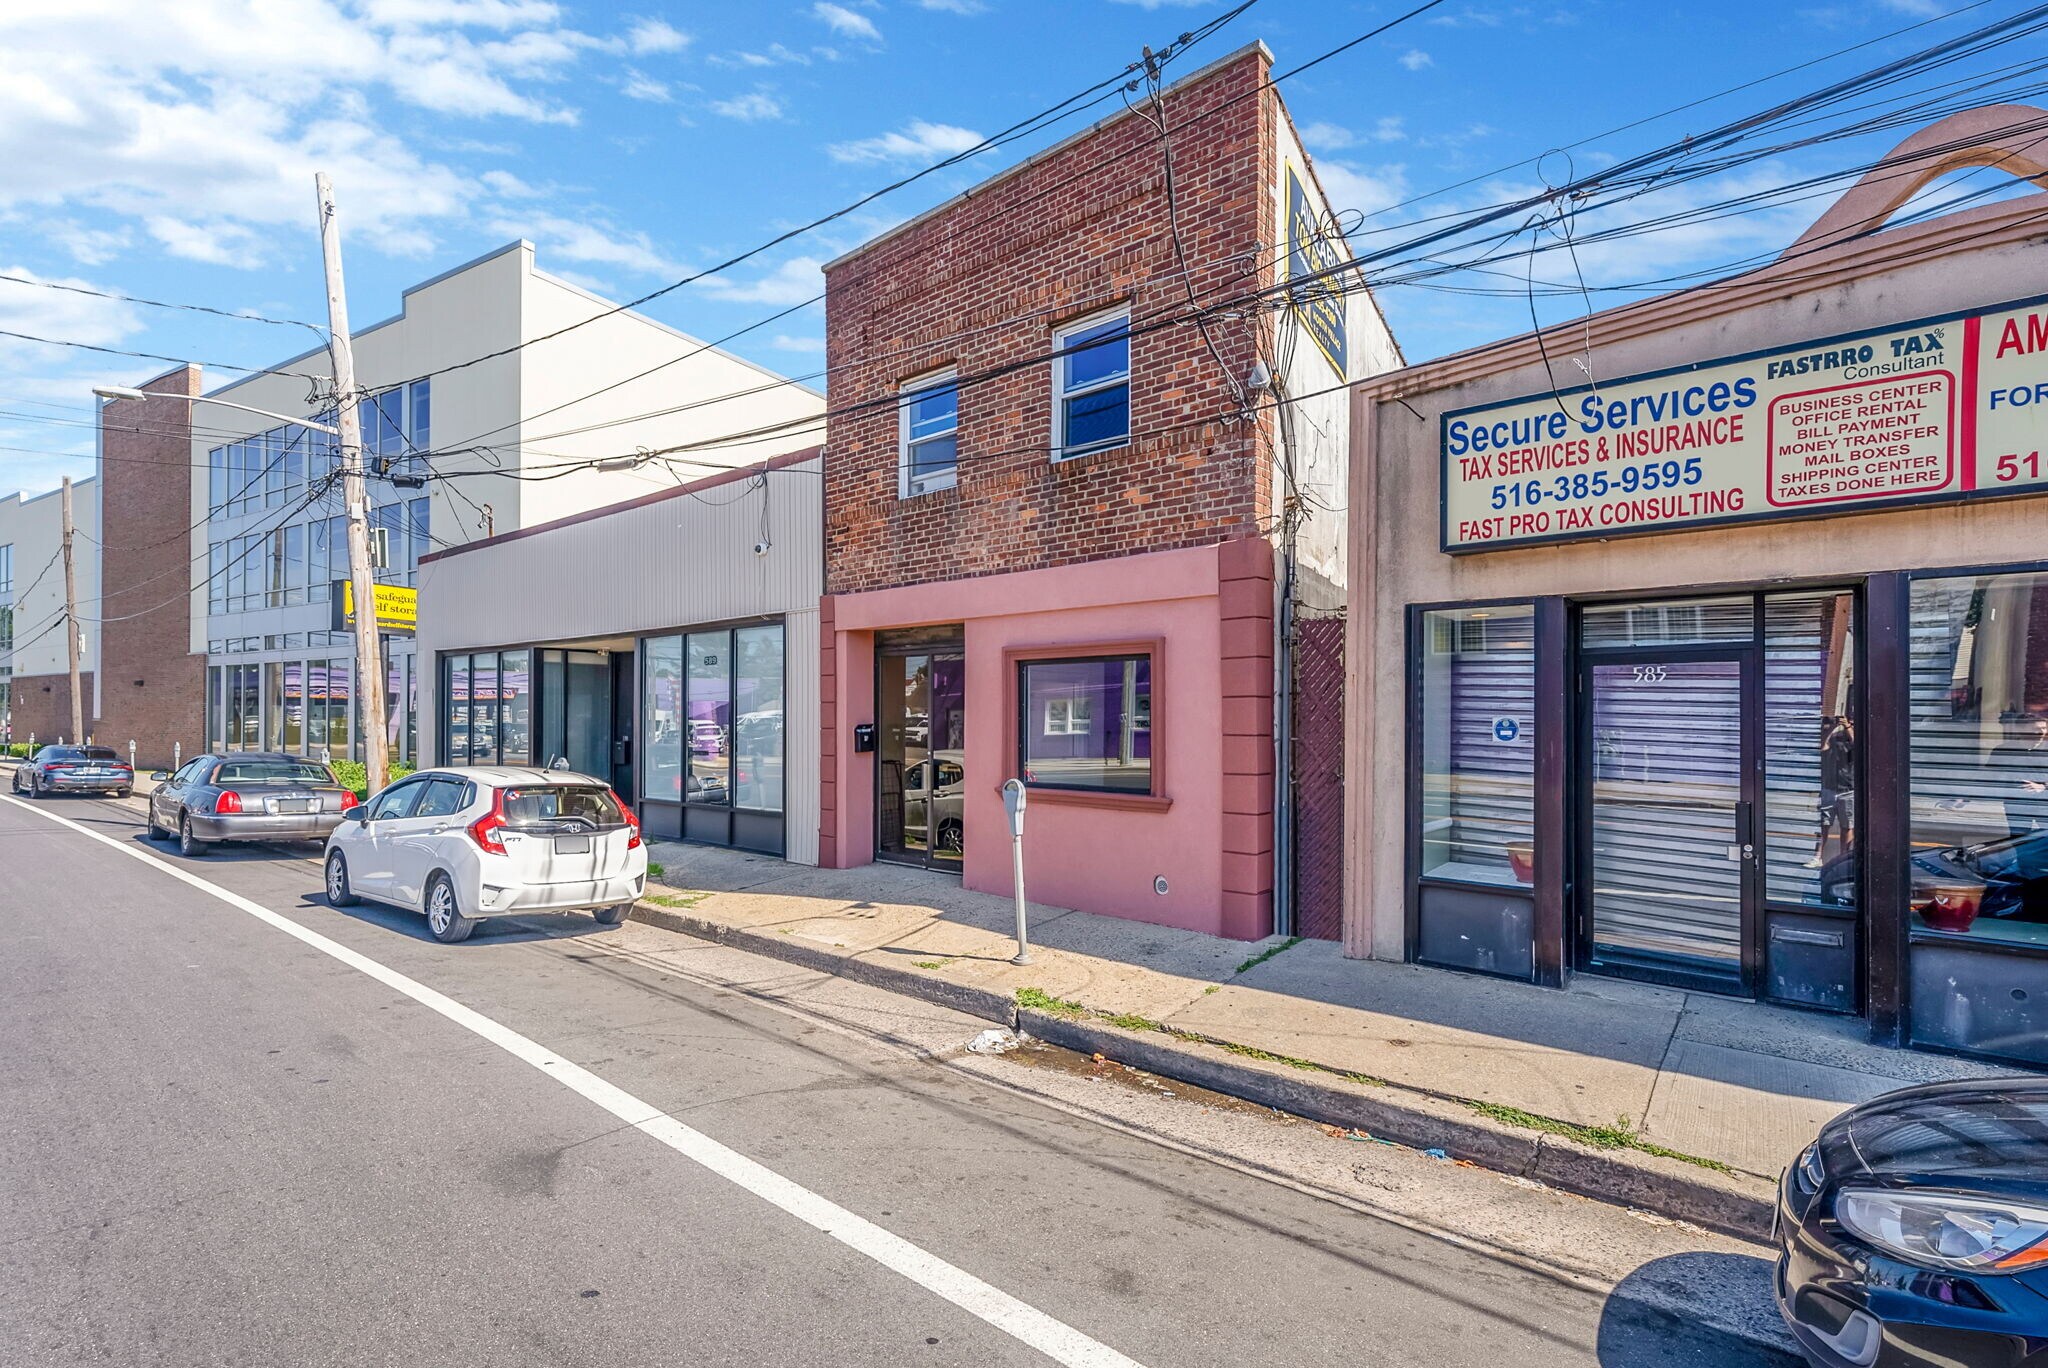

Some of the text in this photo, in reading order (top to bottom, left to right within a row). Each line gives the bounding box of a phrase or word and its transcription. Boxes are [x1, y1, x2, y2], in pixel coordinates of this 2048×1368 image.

[1995, 313, 2048, 359] AM
[1767, 345, 1873, 380] FASTRRO
[1890, 333, 1944, 358] TAX
[1844, 351, 1944, 380] Consultant
[1780, 381, 1942, 415] BUSINESS CENTER
[1792, 398, 1927, 426] OFFICE RENTAL
[1449, 377, 1757, 456] Secure Services
[1797, 413, 1920, 440] BILL PAYMENT
[1460, 414, 1744, 482] TAX SERVICES & INSURANCE
[1779, 426, 1939, 456] MONEY TRANSFER
[1805, 444, 1911, 467] MAIL BOXES
[1781, 455, 1938, 484] SHIPPING CENTER
[1995, 451, 2048, 482] 51
[1491, 457, 1703, 510] 516-385-9595
[1778, 470, 1941, 498] TAXES DONE HERE
[1459, 488, 1744, 541] FAST PRO TAX CONSULTING
[1633, 665, 1667, 683] 585
